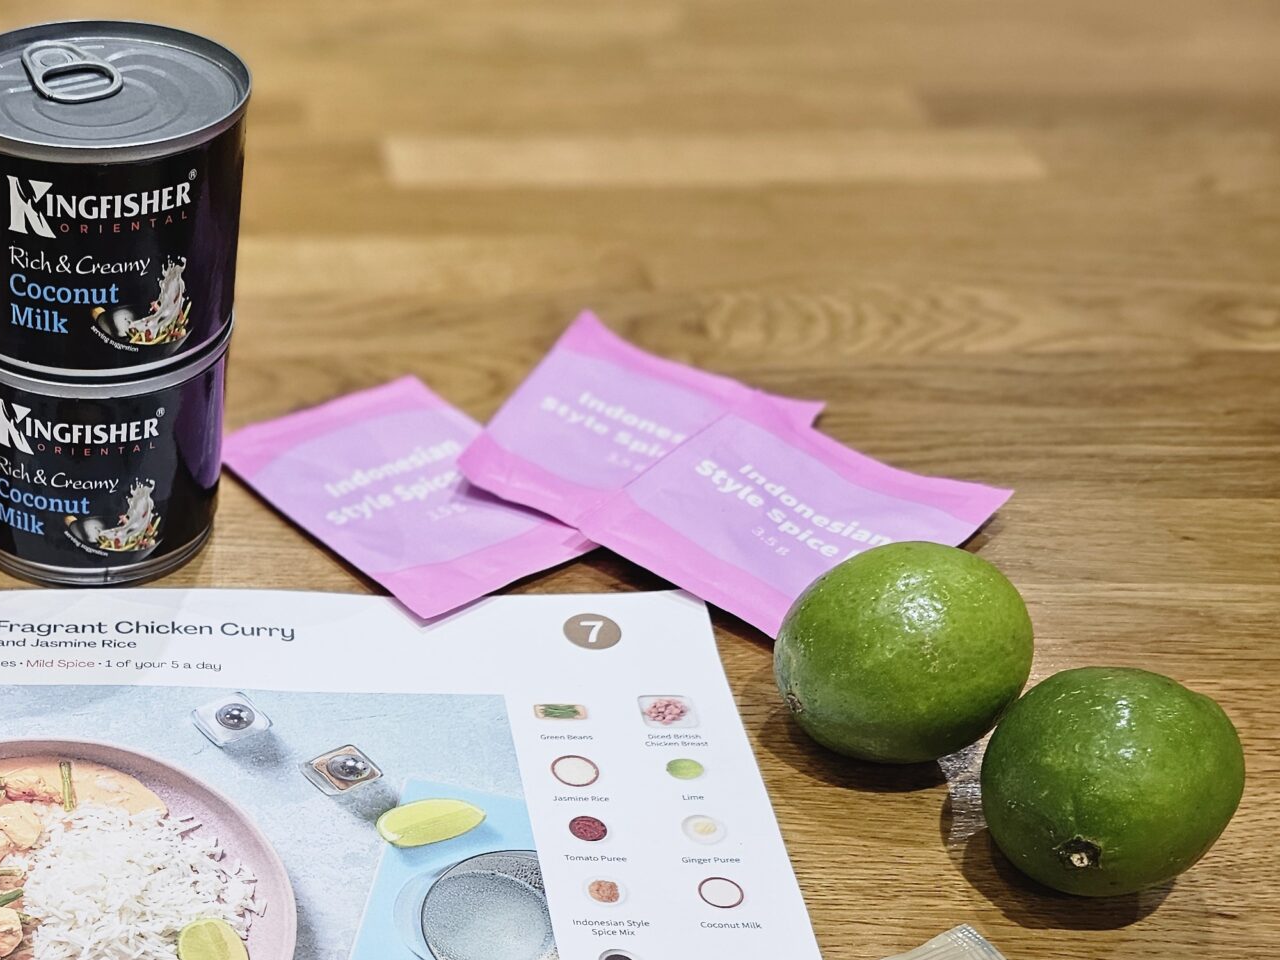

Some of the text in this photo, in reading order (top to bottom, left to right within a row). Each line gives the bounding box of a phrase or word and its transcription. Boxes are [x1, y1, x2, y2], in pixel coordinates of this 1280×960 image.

[6, 174, 192, 239] KINGFISHER
[60, 210, 188, 234] ORIENTAL
[8, 246, 151, 278] Rich & Creamy
[9, 273, 120, 305] Coconut
[10, 302, 69, 335] Milk
[36, 442, 156, 457] ORIENTAL
[33, 469, 47, 486] &
[50, 471, 120, 494] Creamy
[694, 459, 765, 508] Style
[115, 620, 213, 636] Chicken
[220, 622, 295, 642] Curry
[579, 620, 604, 644] 7
[30, 638, 97, 648] Jasmine
[101, 638, 137, 649] Rice
[26, 659, 54, 668] Mild
[57, 659, 95, 669] Spice
[105, 659, 113, 668] 1
[116, 659, 131, 668] of
[135, 661, 167, 670] your
[170, 660, 179, 669] 5
[196, 661, 223, 672] day
[540, 733, 593, 741] Green Beans
[564, 854, 628, 863] Tomato Puree
[681, 856, 711, 865] Ginger
[572, 919, 650, 928] Indonesian Style
[591, 928, 617, 937] Spice
[700, 921, 740, 929] Coconut
